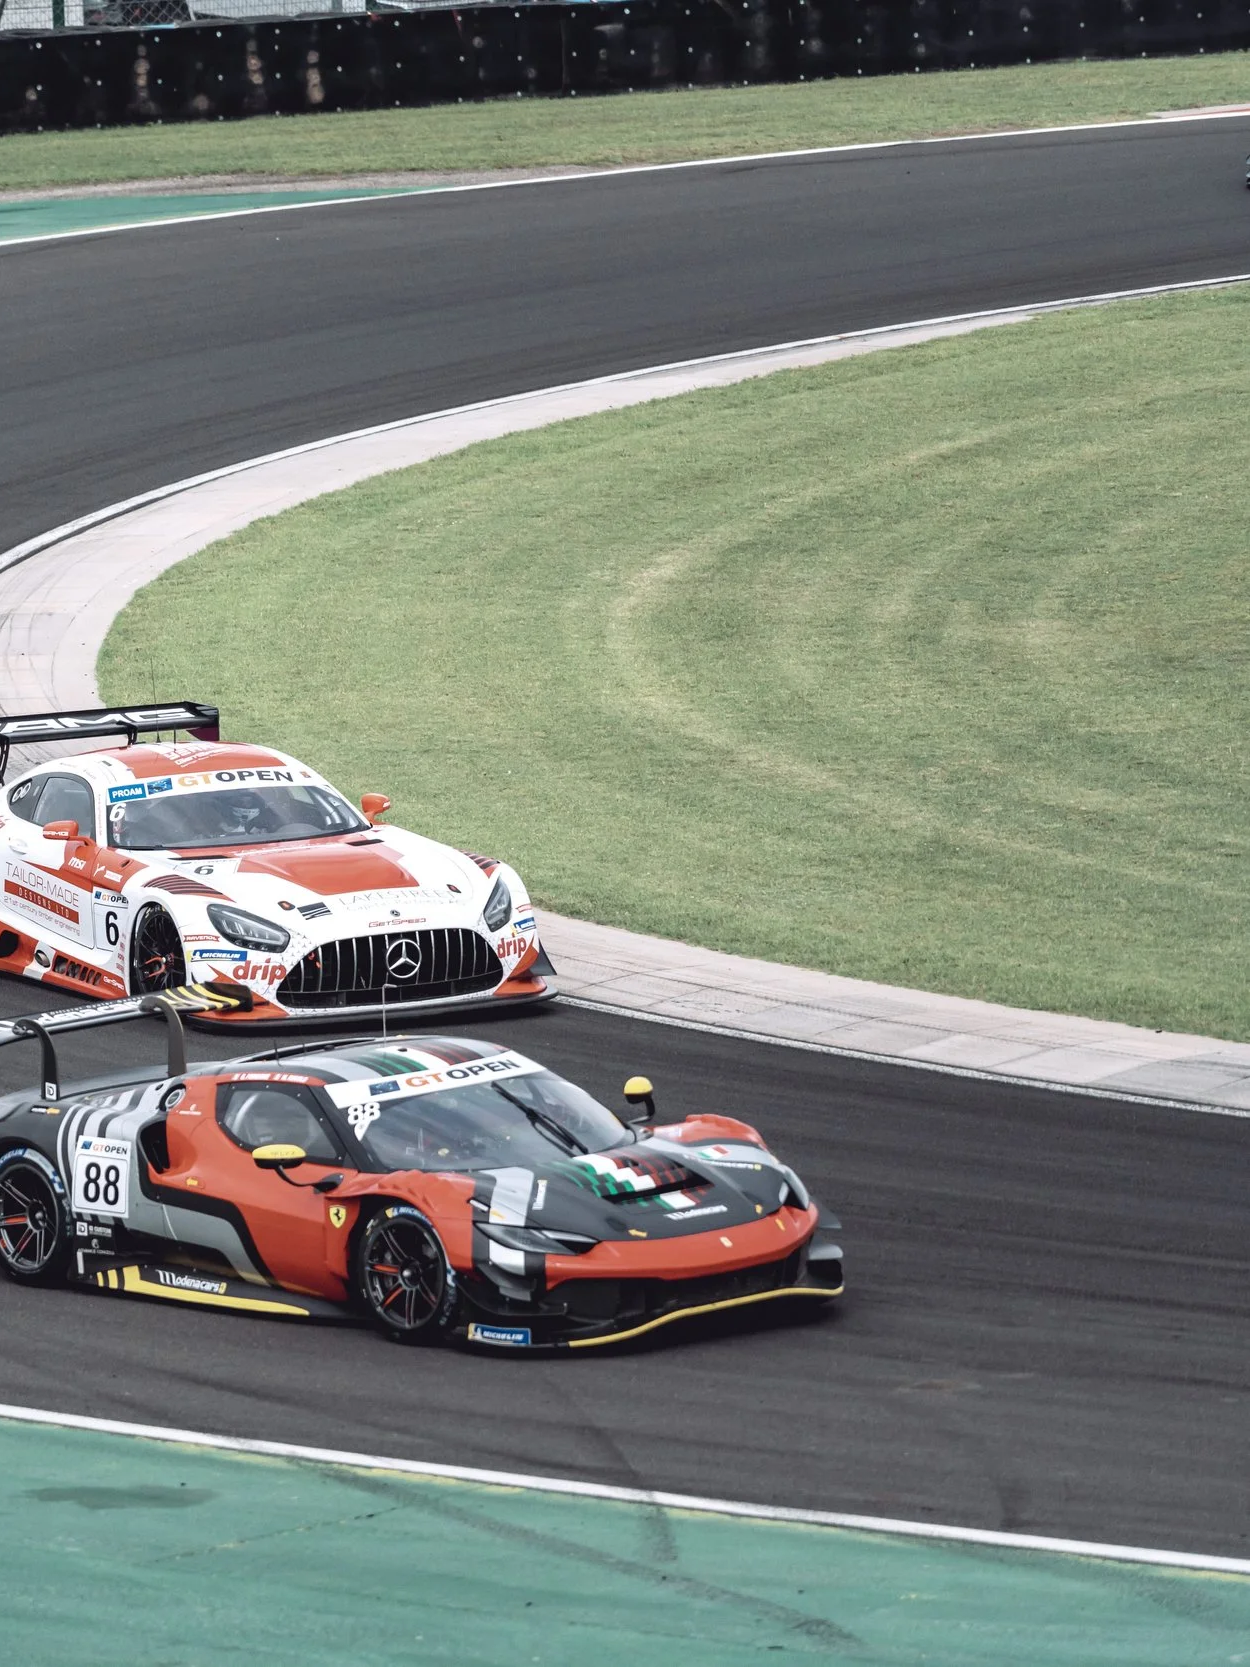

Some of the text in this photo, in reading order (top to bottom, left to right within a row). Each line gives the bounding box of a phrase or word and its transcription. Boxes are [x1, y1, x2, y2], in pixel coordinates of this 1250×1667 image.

[111, 787, 143, 799] PROAM
[109, 802, 126, 823] 6
[194, 864, 214, 876] 6
[5, 861, 79, 908] TAILOR-MADE
[18, 887, 70, 918] DESIGNS LTD
[105, 910, 120, 946] 6
[497, 932, 527, 959] drip
[232, 957, 287, 986] drip
[348, 1102, 381, 1125] 88
[83, 1162, 120, 1206] 88
[482, 1330, 525, 1341] MICHELIN
